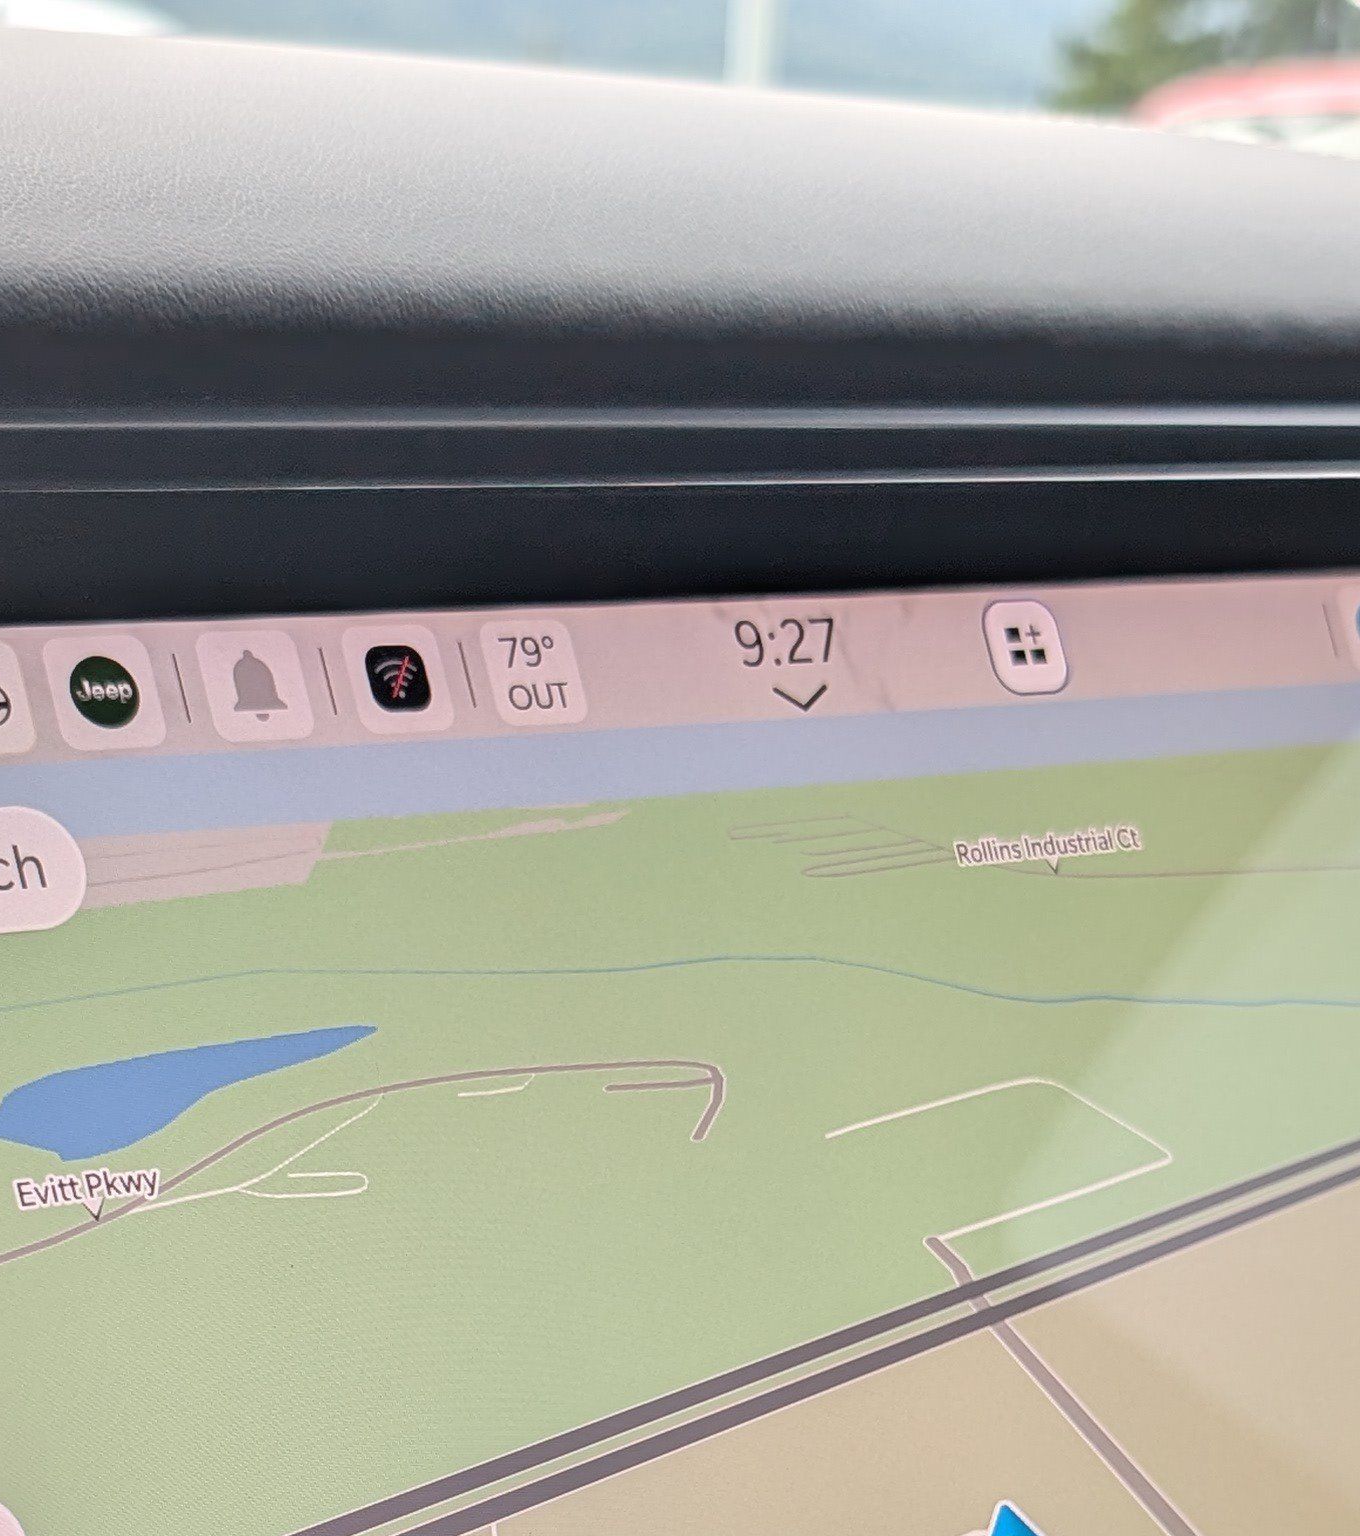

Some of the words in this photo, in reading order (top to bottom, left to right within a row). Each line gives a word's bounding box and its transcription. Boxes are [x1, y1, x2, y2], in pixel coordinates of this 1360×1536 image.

[734, 617, 834, 668] 9:27
[76, 678, 133, 704] Jeep
[508, 682, 568, 711] OUT
[955, 838, 1022, 864] Rollins
[1024, 828, 1113, 857] Industrial
[1116, 827, 1140, 850] Ct
[16, 1177, 82, 1207] Evitt
[85, 1170, 158, 1198] Pkwy
